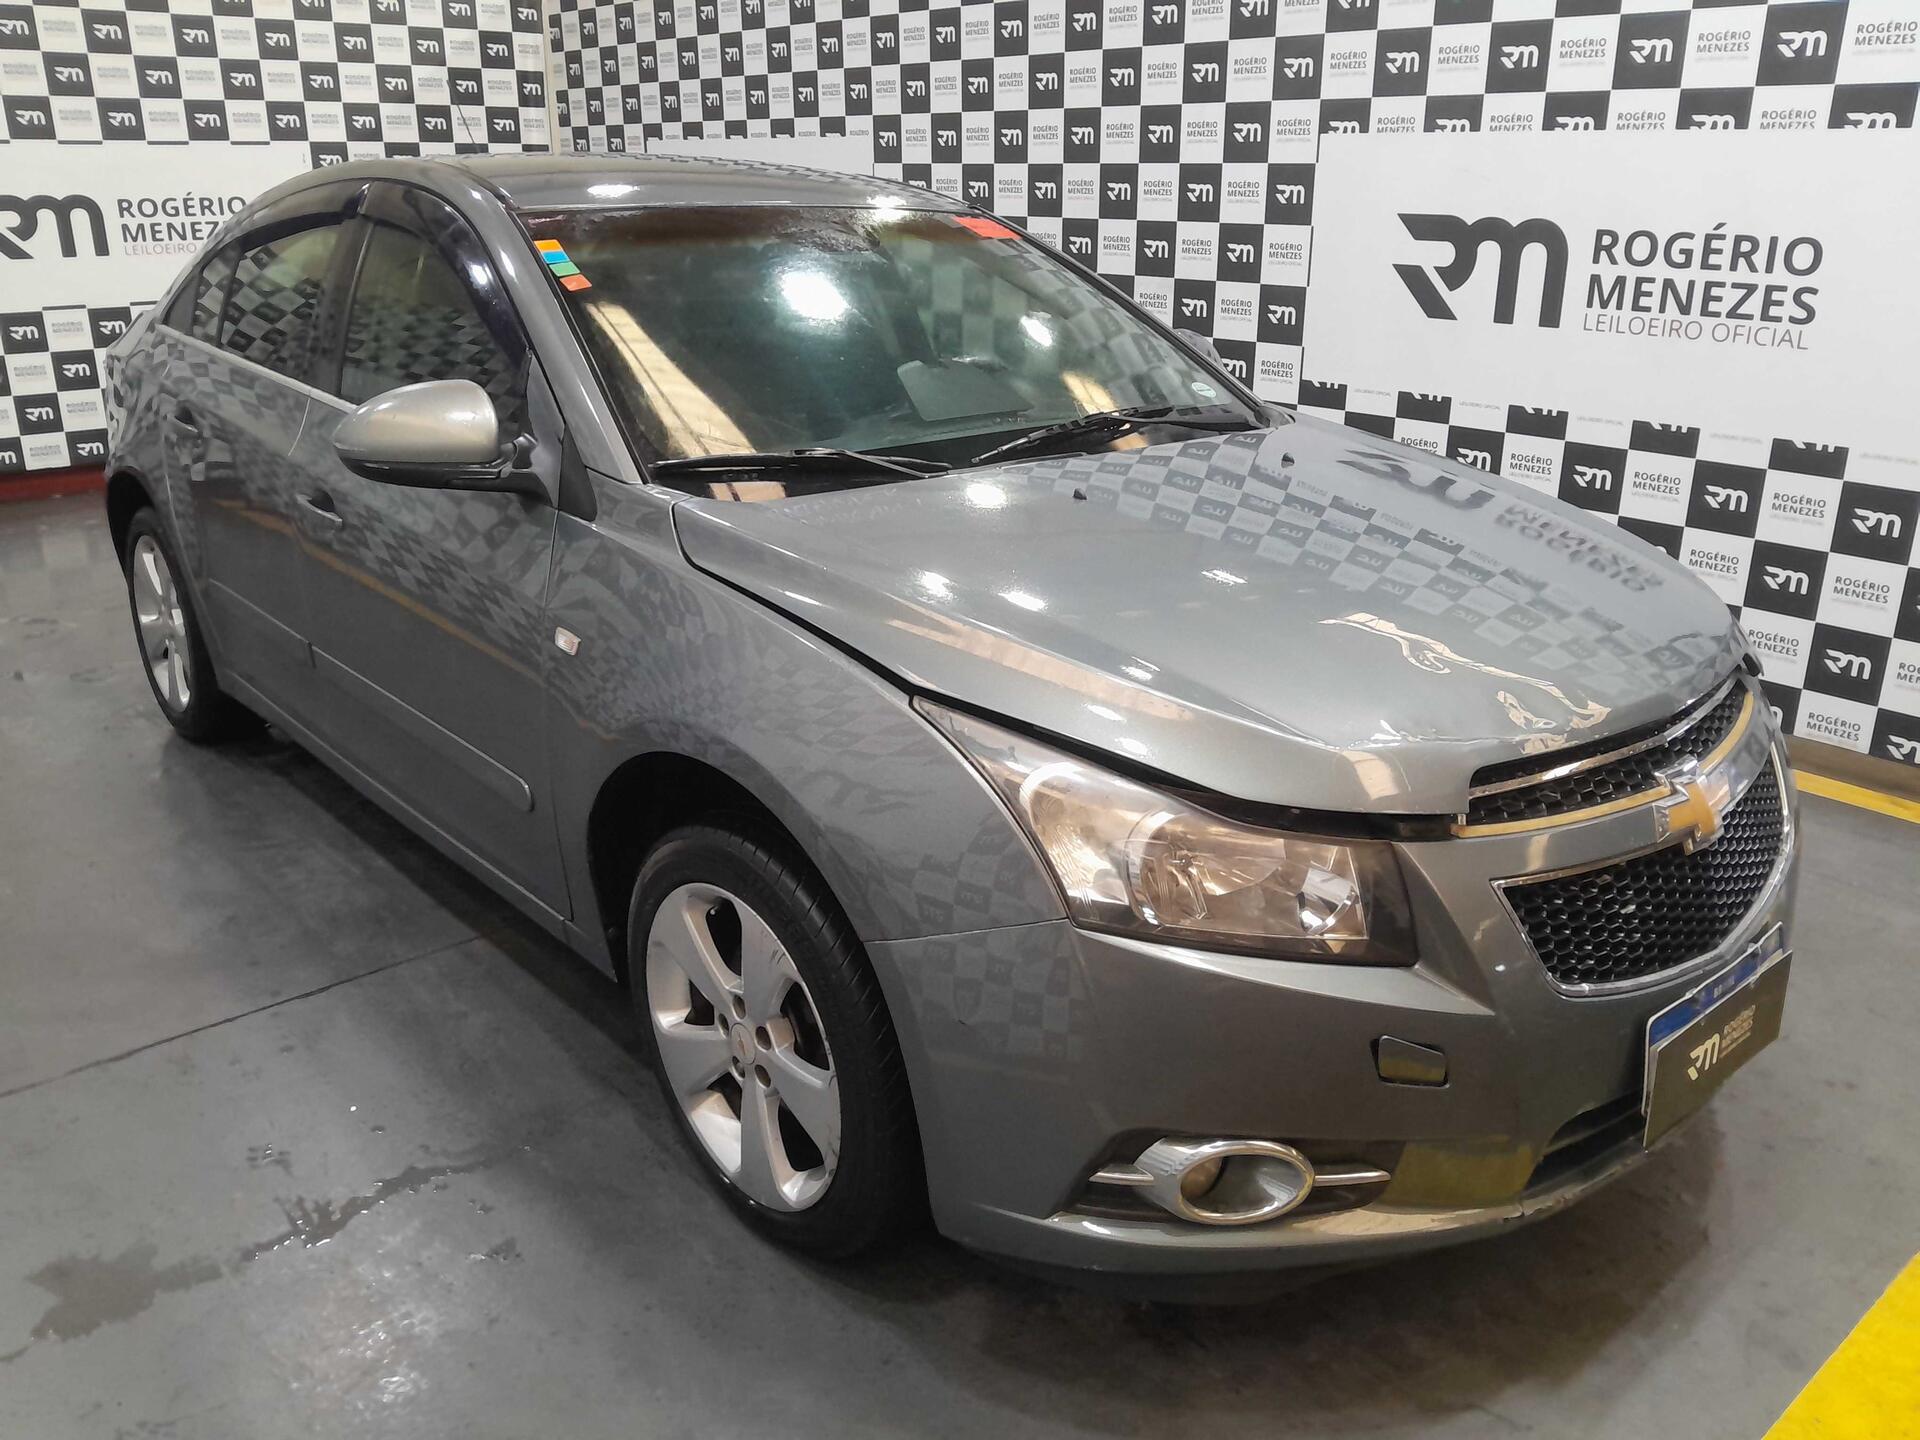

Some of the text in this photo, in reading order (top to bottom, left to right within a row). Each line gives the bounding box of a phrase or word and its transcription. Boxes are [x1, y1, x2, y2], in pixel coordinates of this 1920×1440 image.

[1109, 6, 1137, 14] ROGÉRIO
[1192, 6, 1224, 15] MENEZES
[1034, 14, 1059, 22] ROGÉRIO
[1109, 14, 1137, 22] MENEZES
[1034, 21, 1059, 30] MENEZES
[1857, 22, 1918, 34] ROGÉRIO
[1699, 31, 1751, 42] ROGÉRIO
[1855, 34, 1916, 46] MENEZES
[1561, 38, 1606, 48] ROGÉRIO
[1697, 42, 1749, 53] MENEZES
[1439, 45, 1480, 54] ROGÉRIO
[1560, 48, 1605, 58] MENEZES
[1331, 51, 1367, 60] ROGÉRIO
[1438, 55, 1479, 64] MENEZES
[1234, 57, 1267, 66] ROGÉRIO
[1330, 61, 1366, 69] MENEZES
[1070, 67, 1096, 75] ROGÉRIO
[1148, 62, 1177, 71] ROGÉRIO
[1234, 66, 1266, 74] MENEZES
[1070, 75, 1096, 83] MENEZES
[1148, 71, 1177, 79] MENEZES
[1491, 114, 1533, 124] ROGÉRIO
[1618, 111, 1666, 121] ROGÉRIO
[1762, 110, 1816, 120] ROGÉRIO
[1187, 121, 1218, 129] ROGÉRIO
[1278, 119, 1311, 127] ROGÉRIO
[1378, 116, 1415, 125] ROGÉRIO
[1187, 129, 1218, 137] MENEZES
[1277, 128, 1310, 136] MENEZES
[1144, 180, 1172, 188] ROGÉRIO
[1228, 181, 1260, 189] ROGÉRIO
[1144, 188, 1172, 196] MENEZES
[117, 192, 247, 218] ROGÉRIO
[121, 221, 220, 243] MENEZ
[1182, 239, 1212, 247] ROGÉRIO
[1270, 243, 1302, 251] ROGÉRIO
[124, 242, 198, 256] LEILOEIRO
[1182, 247, 1212, 255] MENEZES
[1592, 222, 1824, 277] ROGÉRIO
[1269, 251, 1302, 260] MENEZES
[1139, 292, 1168, 301] ROGÉRIO
[1585, 273, 1820, 326] MENEZES
[1221, 299, 1252, 308] ROGÉRIO
[1221, 307, 1252, 316] MENEZES
[1583, 312, 1810, 351] LEILOEIRO OFICIAL
[1261, 360, 1293, 370] ROGÉRIO
[1261, 368, 1293, 378] MENEZES
[1511, 453, 1552, 466] ROGÉRIO
[1510, 462, 1552, 475] MENEZES
[1634, 472, 1681, 486] ROGÉRIO
[1633, 480, 1680, 495] MENEZES
[1774, 493, 1826, 508] ROGÉRIO
[1772, 502, 1824, 518] MENEZES
[1690, 549, 1739, 565] ROGÉRIO
[1689, 558, 1738, 574] MENEZES
[1836, 576, 1890, 593] ROGÉRIO
[1834, 586, 1888, 604] MENEZES
[1748, 629, 1799, 648] ROGÉRIO
[1809, 712, 1860, 732] ROGÉRIO
[1807, 722, 1859, 741] MENEZES
